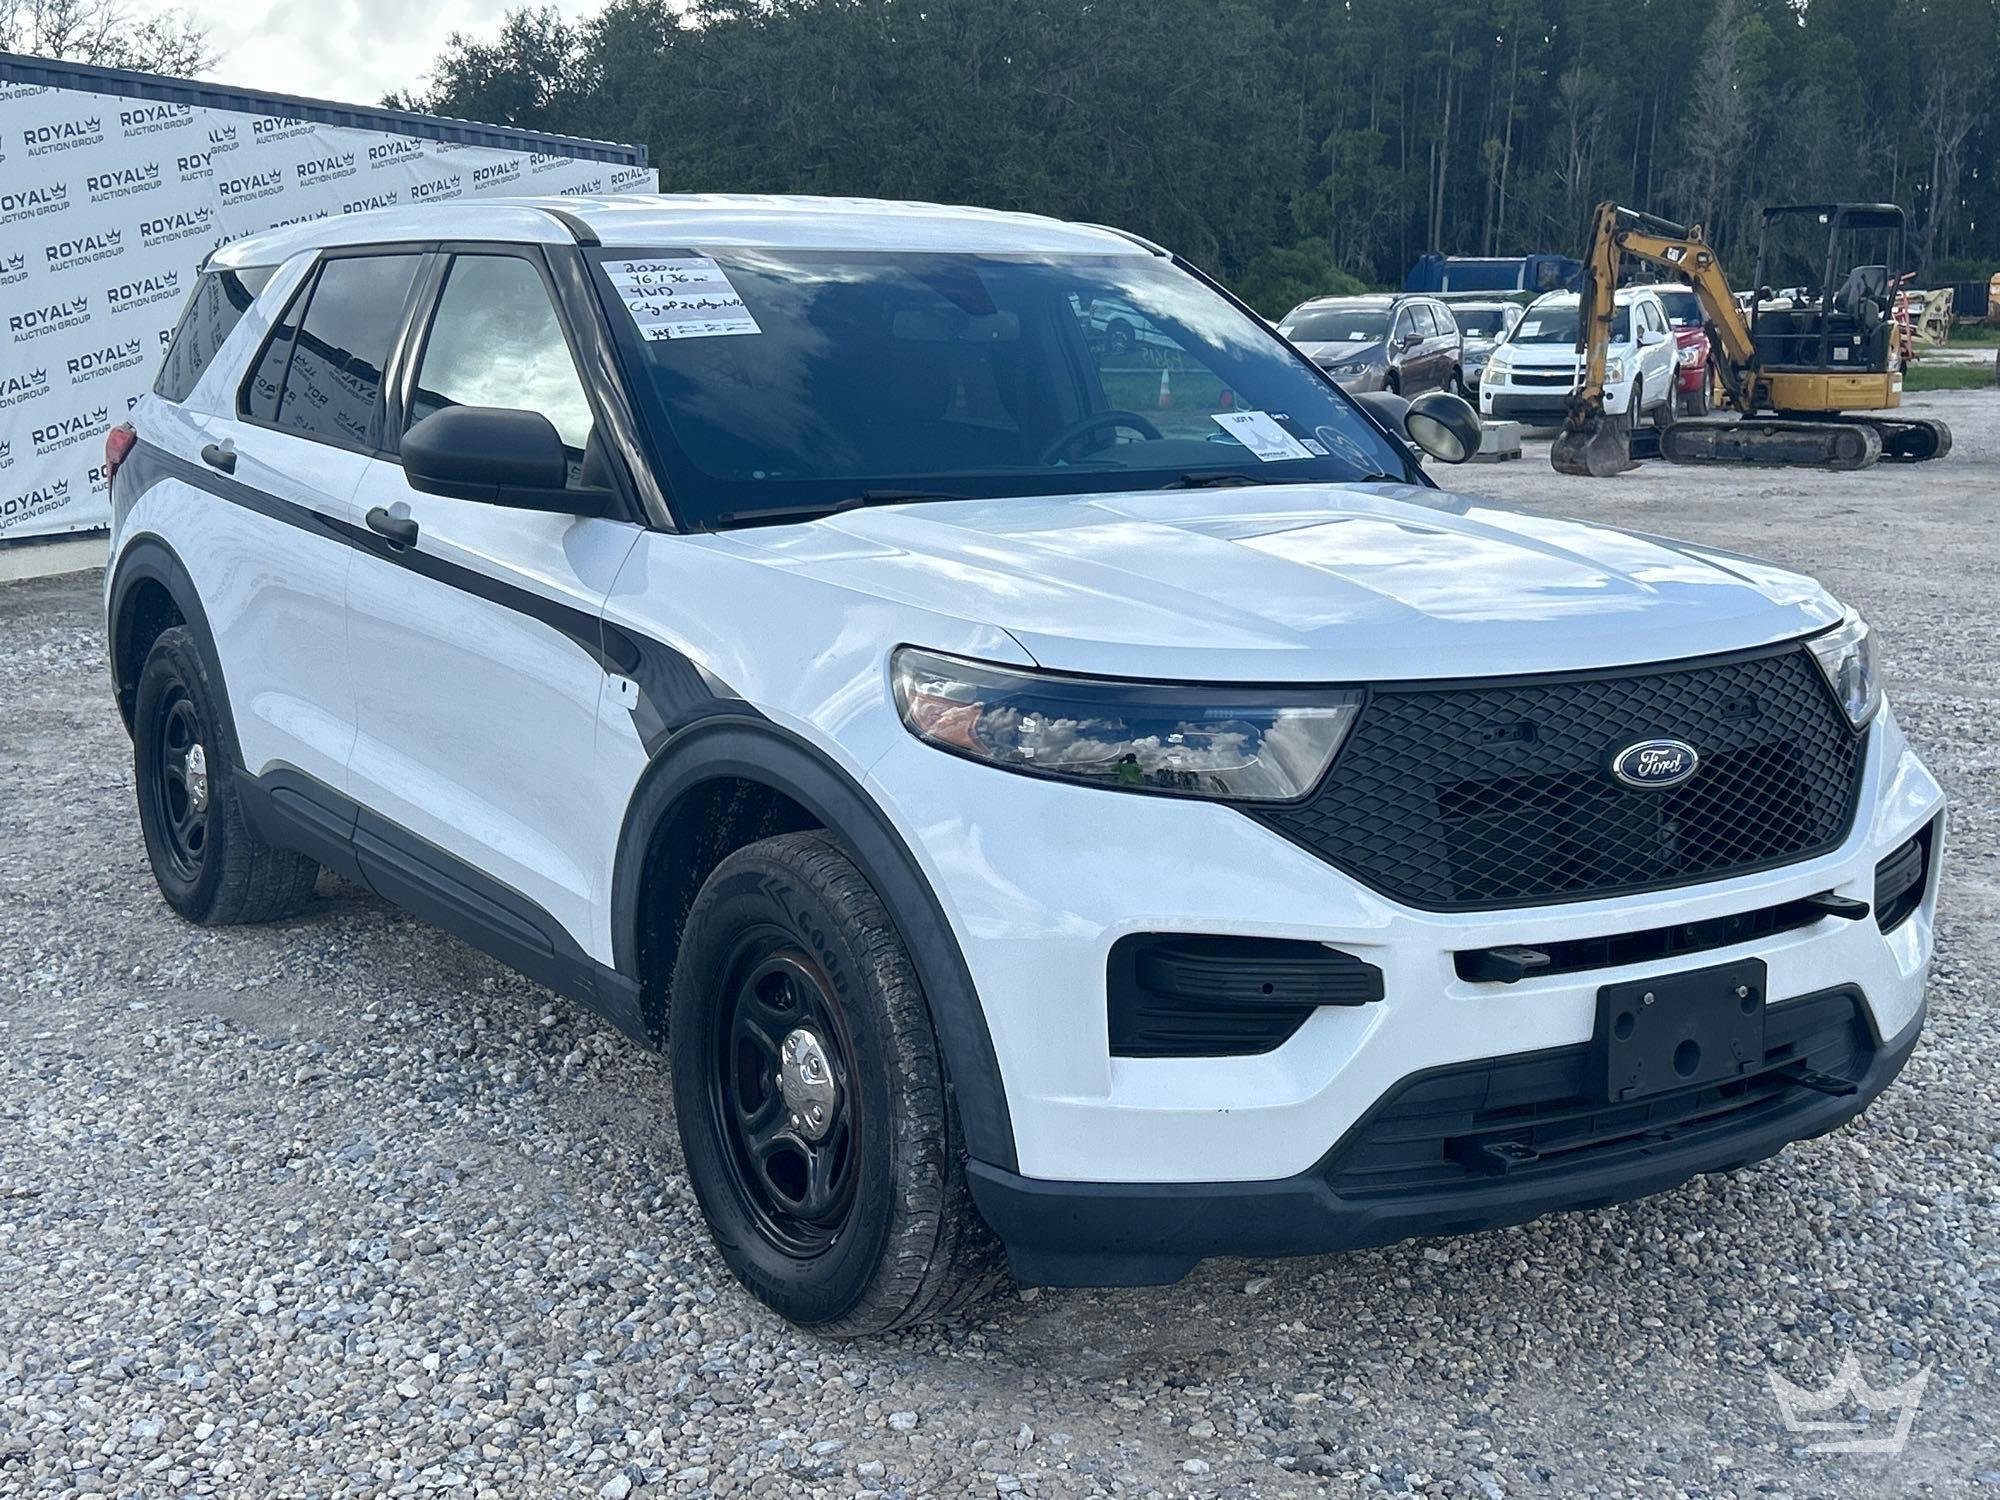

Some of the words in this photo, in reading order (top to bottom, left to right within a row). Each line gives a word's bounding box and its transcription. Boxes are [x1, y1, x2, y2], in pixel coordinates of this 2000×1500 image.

[14, 86, 48, 98] GROUP
[120, 104, 177, 126] ROYAL
[24, 122, 86, 146] ROYAL
[124, 124, 162, 138] AUCTION
[164, 117, 194, 130] GROUP
[256, 130, 289, 144] AUCTION
[290, 126, 316, 137] GROUP
[28, 142, 70, 157] AUCTION
[72, 134, 104, 148] GROUP
[210, 142, 239, 154] GROUP
[368, 140, 412, 160] ROYAL
[177, 152, 212, 172] ROY
[296, 156, 342, 178] ROYAL
[371, 156, 400, 170] AUCTION
[473, 162, 510, 182] ROYAL
[532, 164, 555, 174] AUCTION
[87, 168, 146, 192] ROYAL
[181, 169, 214, 182] AUCTIO
[219, 174, 270, 196] ROYAL
[300, 175, 332, 188] AUCTION
[332, 168, 356, 180] GROUP
[474, 178, 500, 190] AUCTION
[611, 168, 642, 186] ROYAL
[91, 188, 130, 203] AUCTION
[132, 180, 162, 194] GROUP
[222, 192, 257, 206] AUCTION
[258, 186, 284, 198] GROUP
[410, 178, 450, 198] ROYAL
[560, 183, 593, 196] ROYAL
[0, 188, 52, 212] OYAL
[344, 196, 387, 214] ROYAL
[0, 210, 36, 224] UCTION
[36, 202, 70, 216] GROUP
[140, 212, 196, 237] ROYAL
[144, 232, 180, 248] AUCTION
[182, 224, 212, 238] GROUP
[46, 234, 107, 261] ROYAL
[50, 257, 92, 272] AUCTION
[92, 246, 124, 262] GROUP
[1, 272, 28, 285] ROUP
[107, 276, 164, 304] ROYAL
[112, 297, 150, 314] AUCTION
[151, 288, 180, 303] GROUP
[630, 286, 674, 298] 4WD
[10, 302, 73, 332] ROYAL
[630, 301, 660, 316] City
[14, 324, 56, 343] AUCTION
[58, 314, 90, 330] GROUP
[66, 345, 126, 374] ROYAL
[72, 366, 112, 384] AUCTION
[112, 355, 144, 372] GROUP
[0, 376, 31, 396] YAL
[16, 386, 50, 402] GROUP
[32, 414, 94, 445] ROYAL
[36, 436, 78, 456] AUCTION
[79, 424, 111, 441] GROUP
[0, 488, 54, 517] OYAL
[0, 509, 36, 530] UCTION
[37, 496, 72, 516] GROUP
[1638, 750, 1682, 777] Ford
